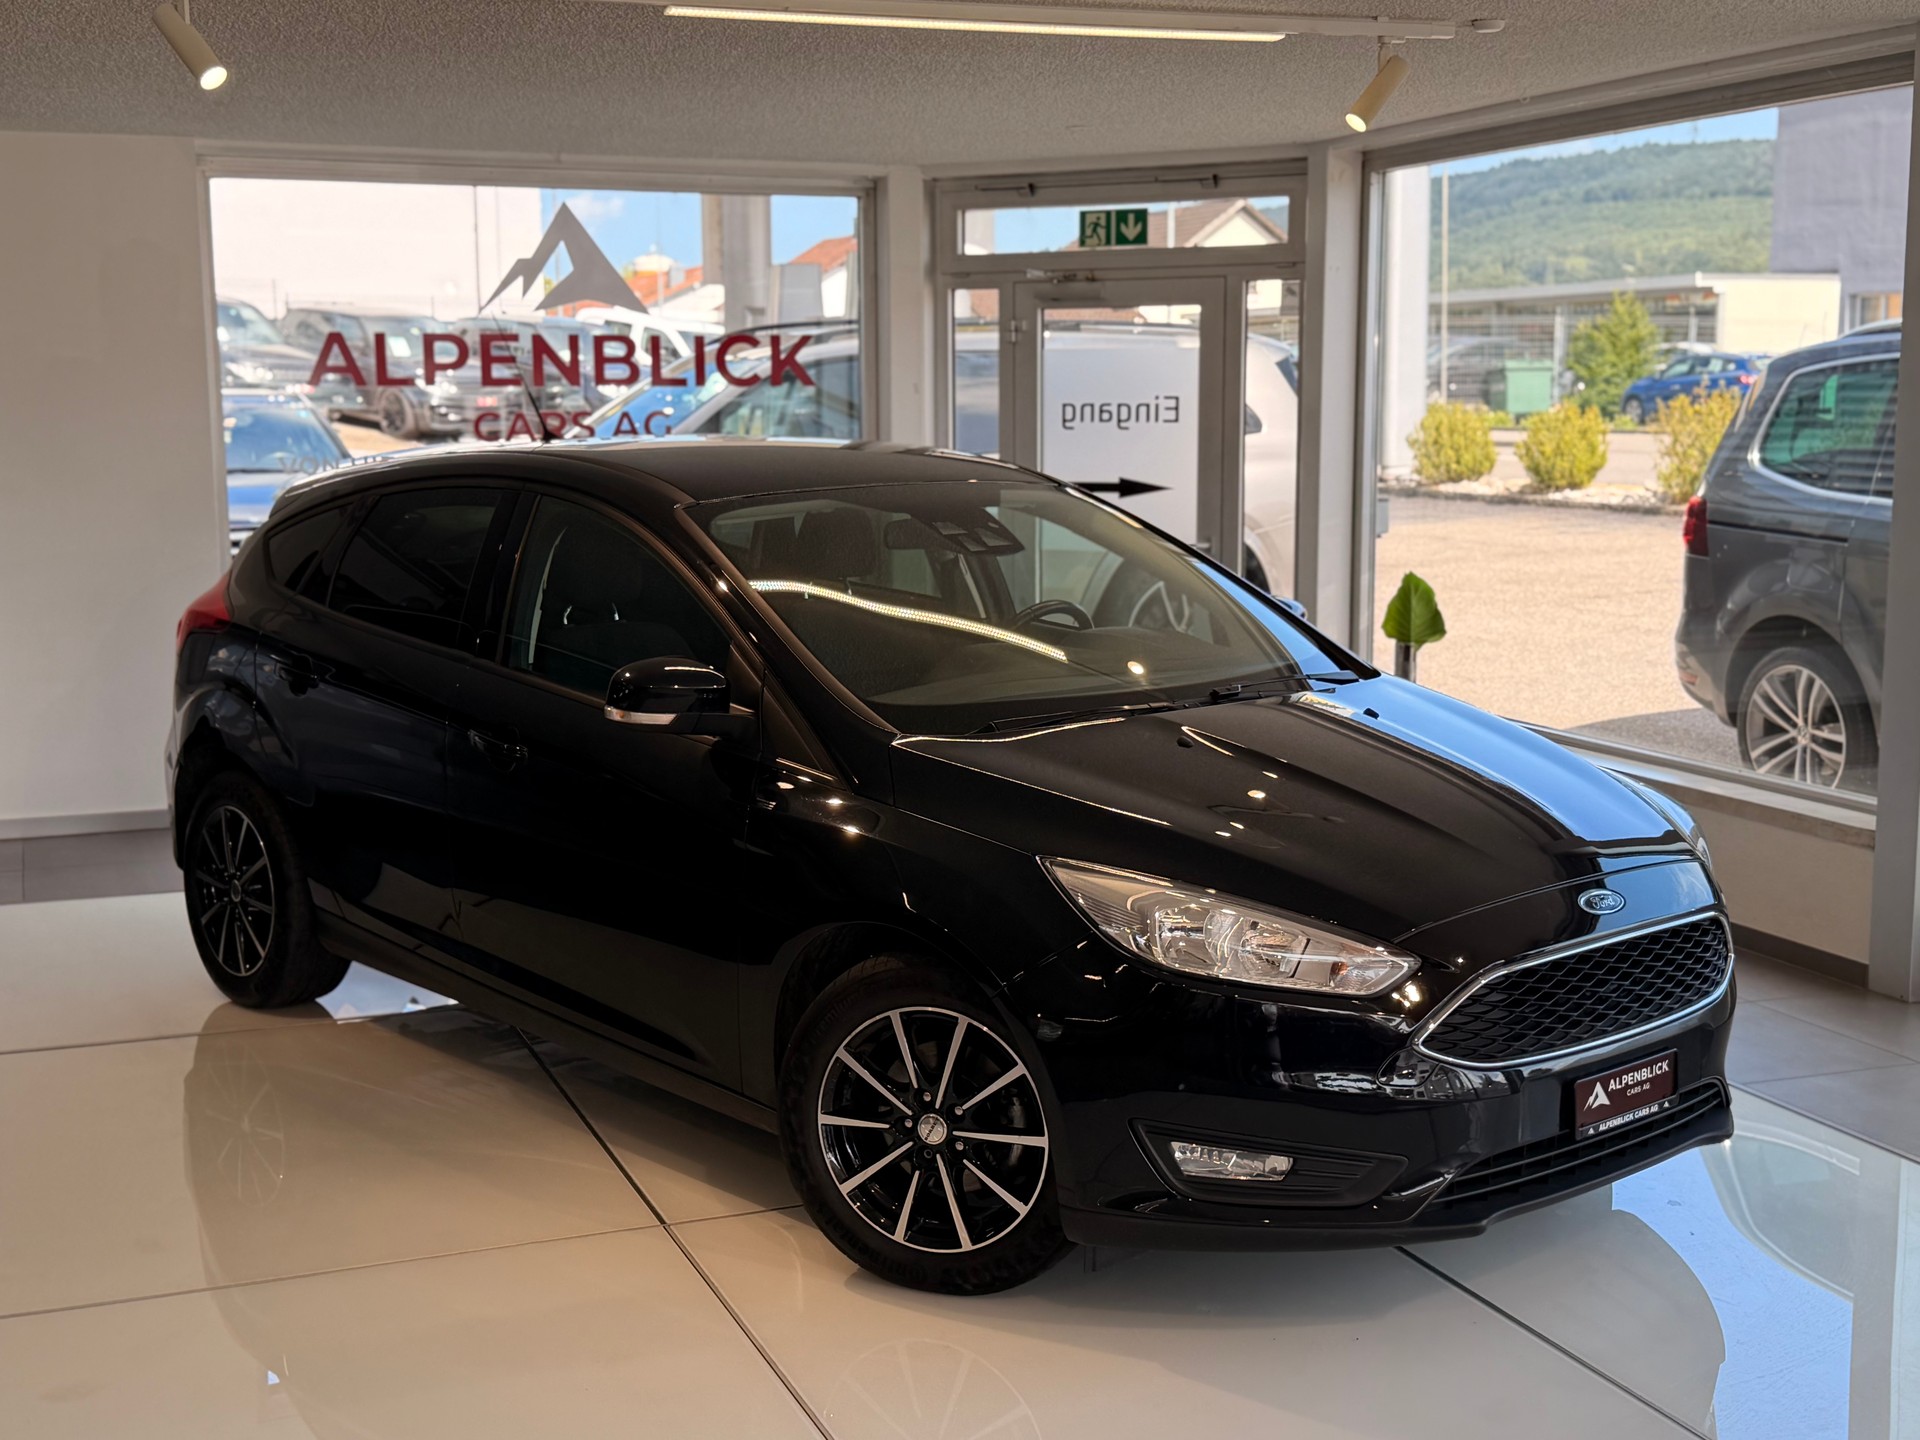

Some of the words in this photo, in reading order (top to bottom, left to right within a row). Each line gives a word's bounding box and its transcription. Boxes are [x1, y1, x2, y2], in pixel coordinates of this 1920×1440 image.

[308, 332, 816, 387] ALPENBLICK
[473, 411, 595, 441] CARS
[612, 411, 672, 437] AG
[1589, 895, 1615, 909] Ford
[1608, 1059, 1669, 1092] ALPENBLICK
[1626, 1085, 1642, 1096] CARS
[1642, 1082, 1651, 1090] AG
[1598, 1114, 1634, 1132] ALPENBLICK
[1634, 1107, 1650, 1118] CARS
[1649, 1104, 1659, 1114] AG
